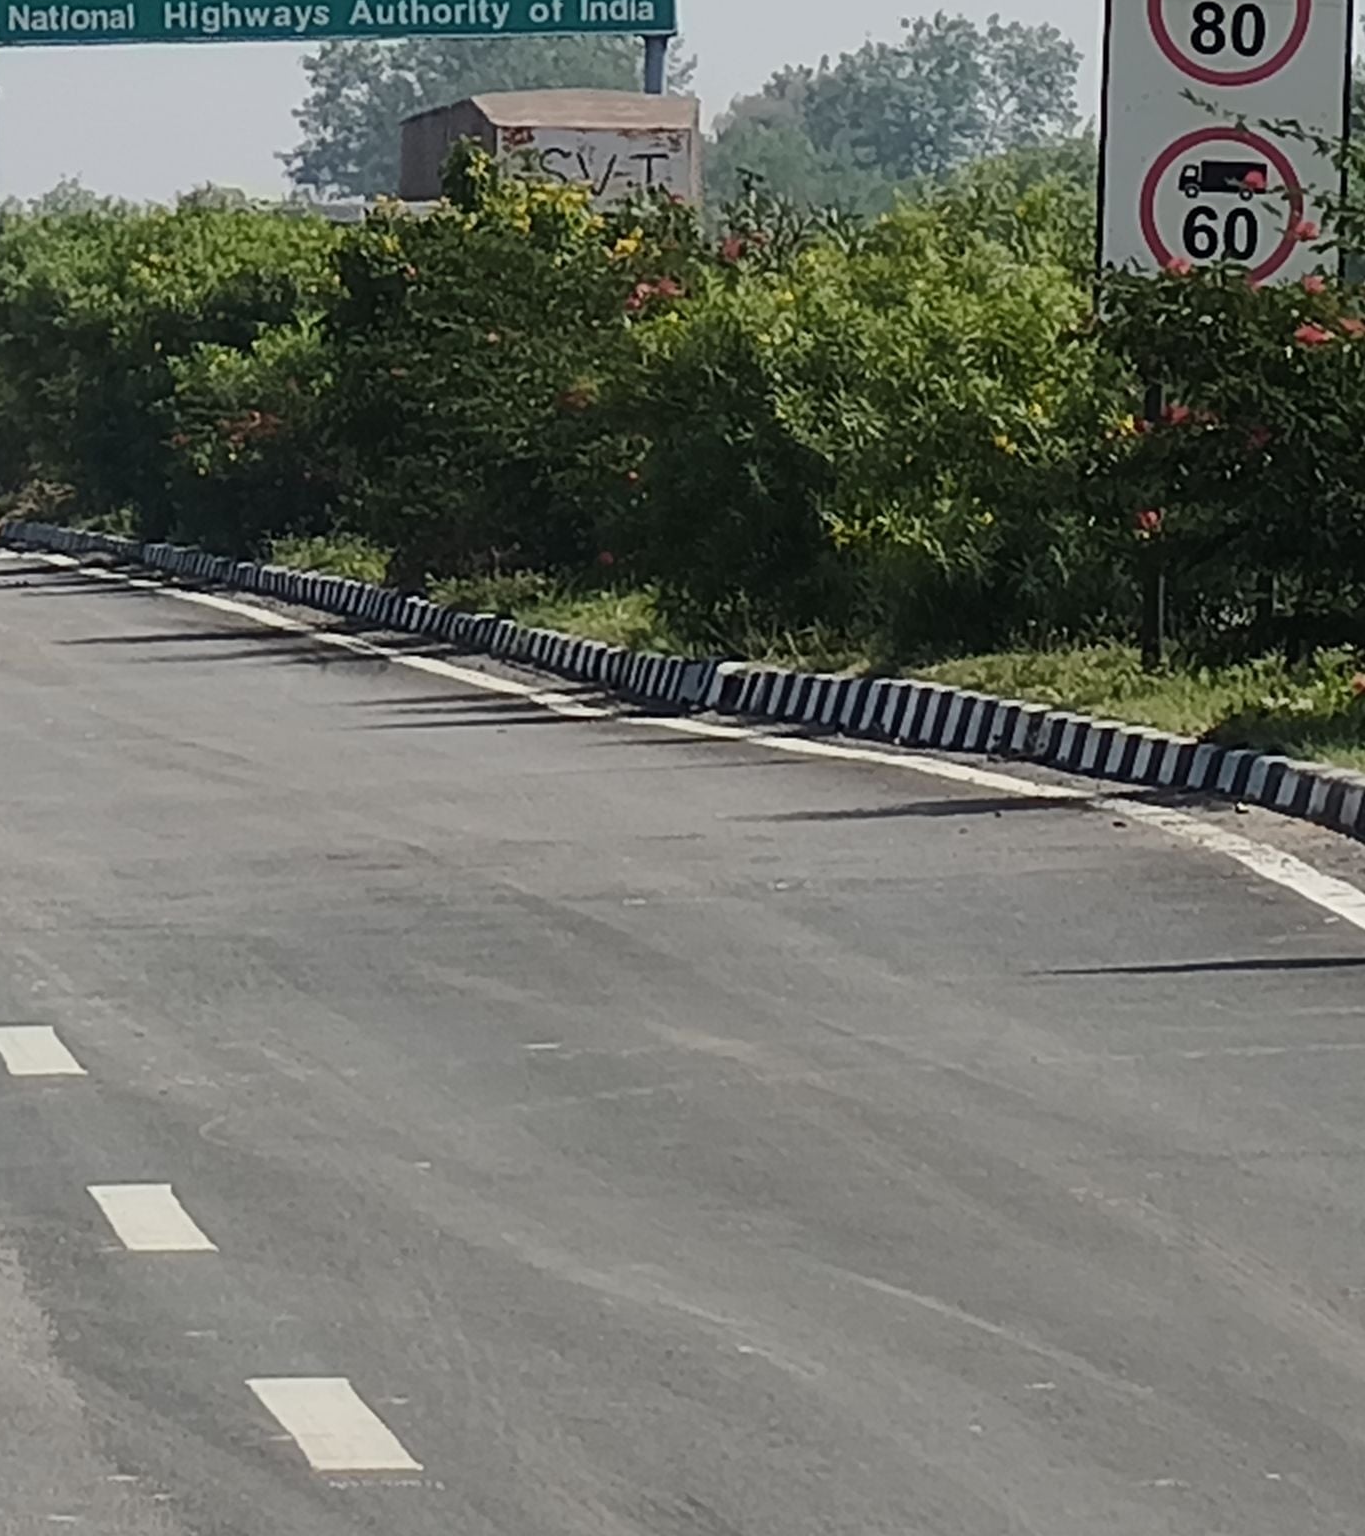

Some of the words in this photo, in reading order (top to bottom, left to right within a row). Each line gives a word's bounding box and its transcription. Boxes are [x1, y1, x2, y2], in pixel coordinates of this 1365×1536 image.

[8, 3, 135, 32] National
[164, 1, 330, 33] Highways
[1190, 1, 1266, 57] 80
[1182, 206, 1259, 260] 60
